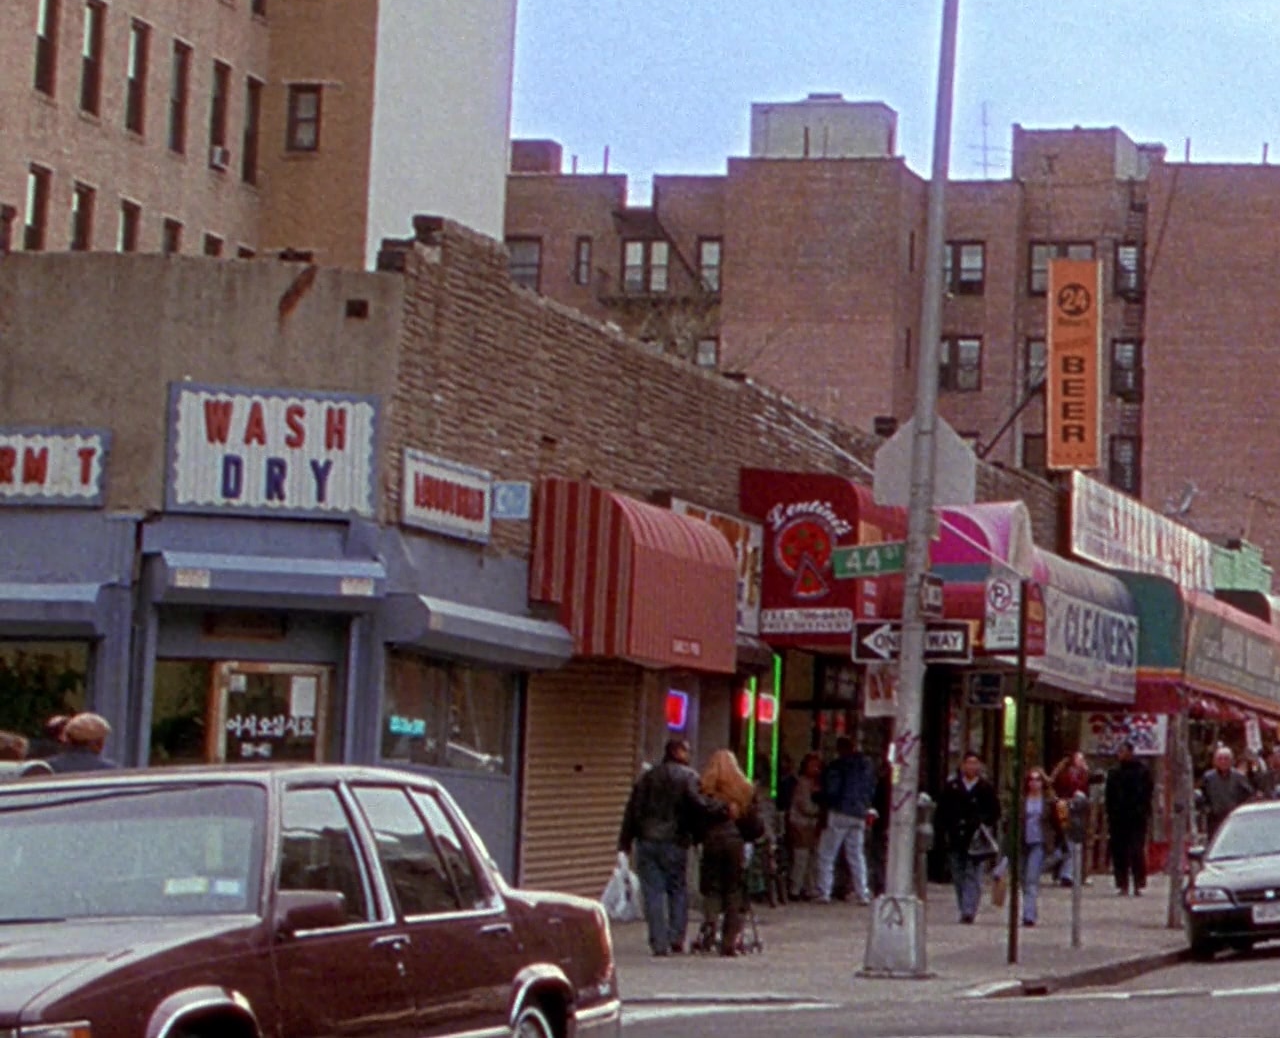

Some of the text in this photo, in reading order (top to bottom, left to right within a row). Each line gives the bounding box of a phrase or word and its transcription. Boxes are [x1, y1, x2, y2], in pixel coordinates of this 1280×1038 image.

[1062, 288, 1087, 310] 24
[1062, 355, 1085, 443] BEER
[204, 399, 347, 451] WASH
[220, 453, 332, 502] DRY
[846, 548, 881, 574] 44
[874, 632, 959, 650] ON WAY
[1064, 603, 1134, 668] CLEANERS
